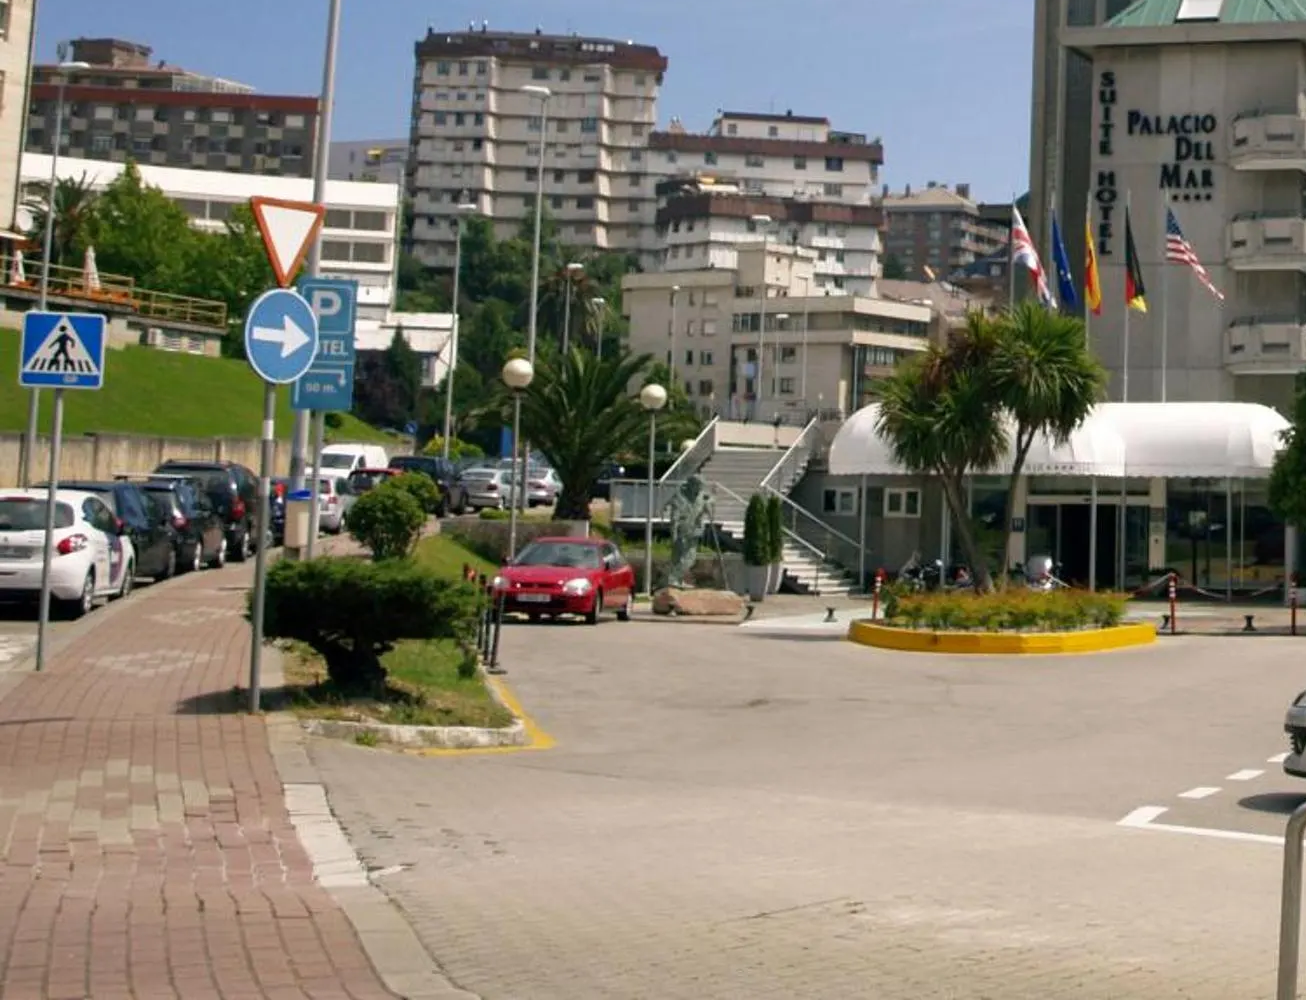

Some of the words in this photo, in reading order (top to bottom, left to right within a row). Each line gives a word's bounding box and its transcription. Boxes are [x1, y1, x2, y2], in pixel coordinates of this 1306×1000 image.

[1101, 71, 1117, 156] SUITE
[1127, 110, 1217, 135] PALACIO
[1175, 137, 1215, 161] DEL
[1159, 164, 1213, 188] MAR
[1096, 171, 1117, 255] HOTEL
[312, 290, 342, 328] P
[319, 340, 349, 356] TEL
